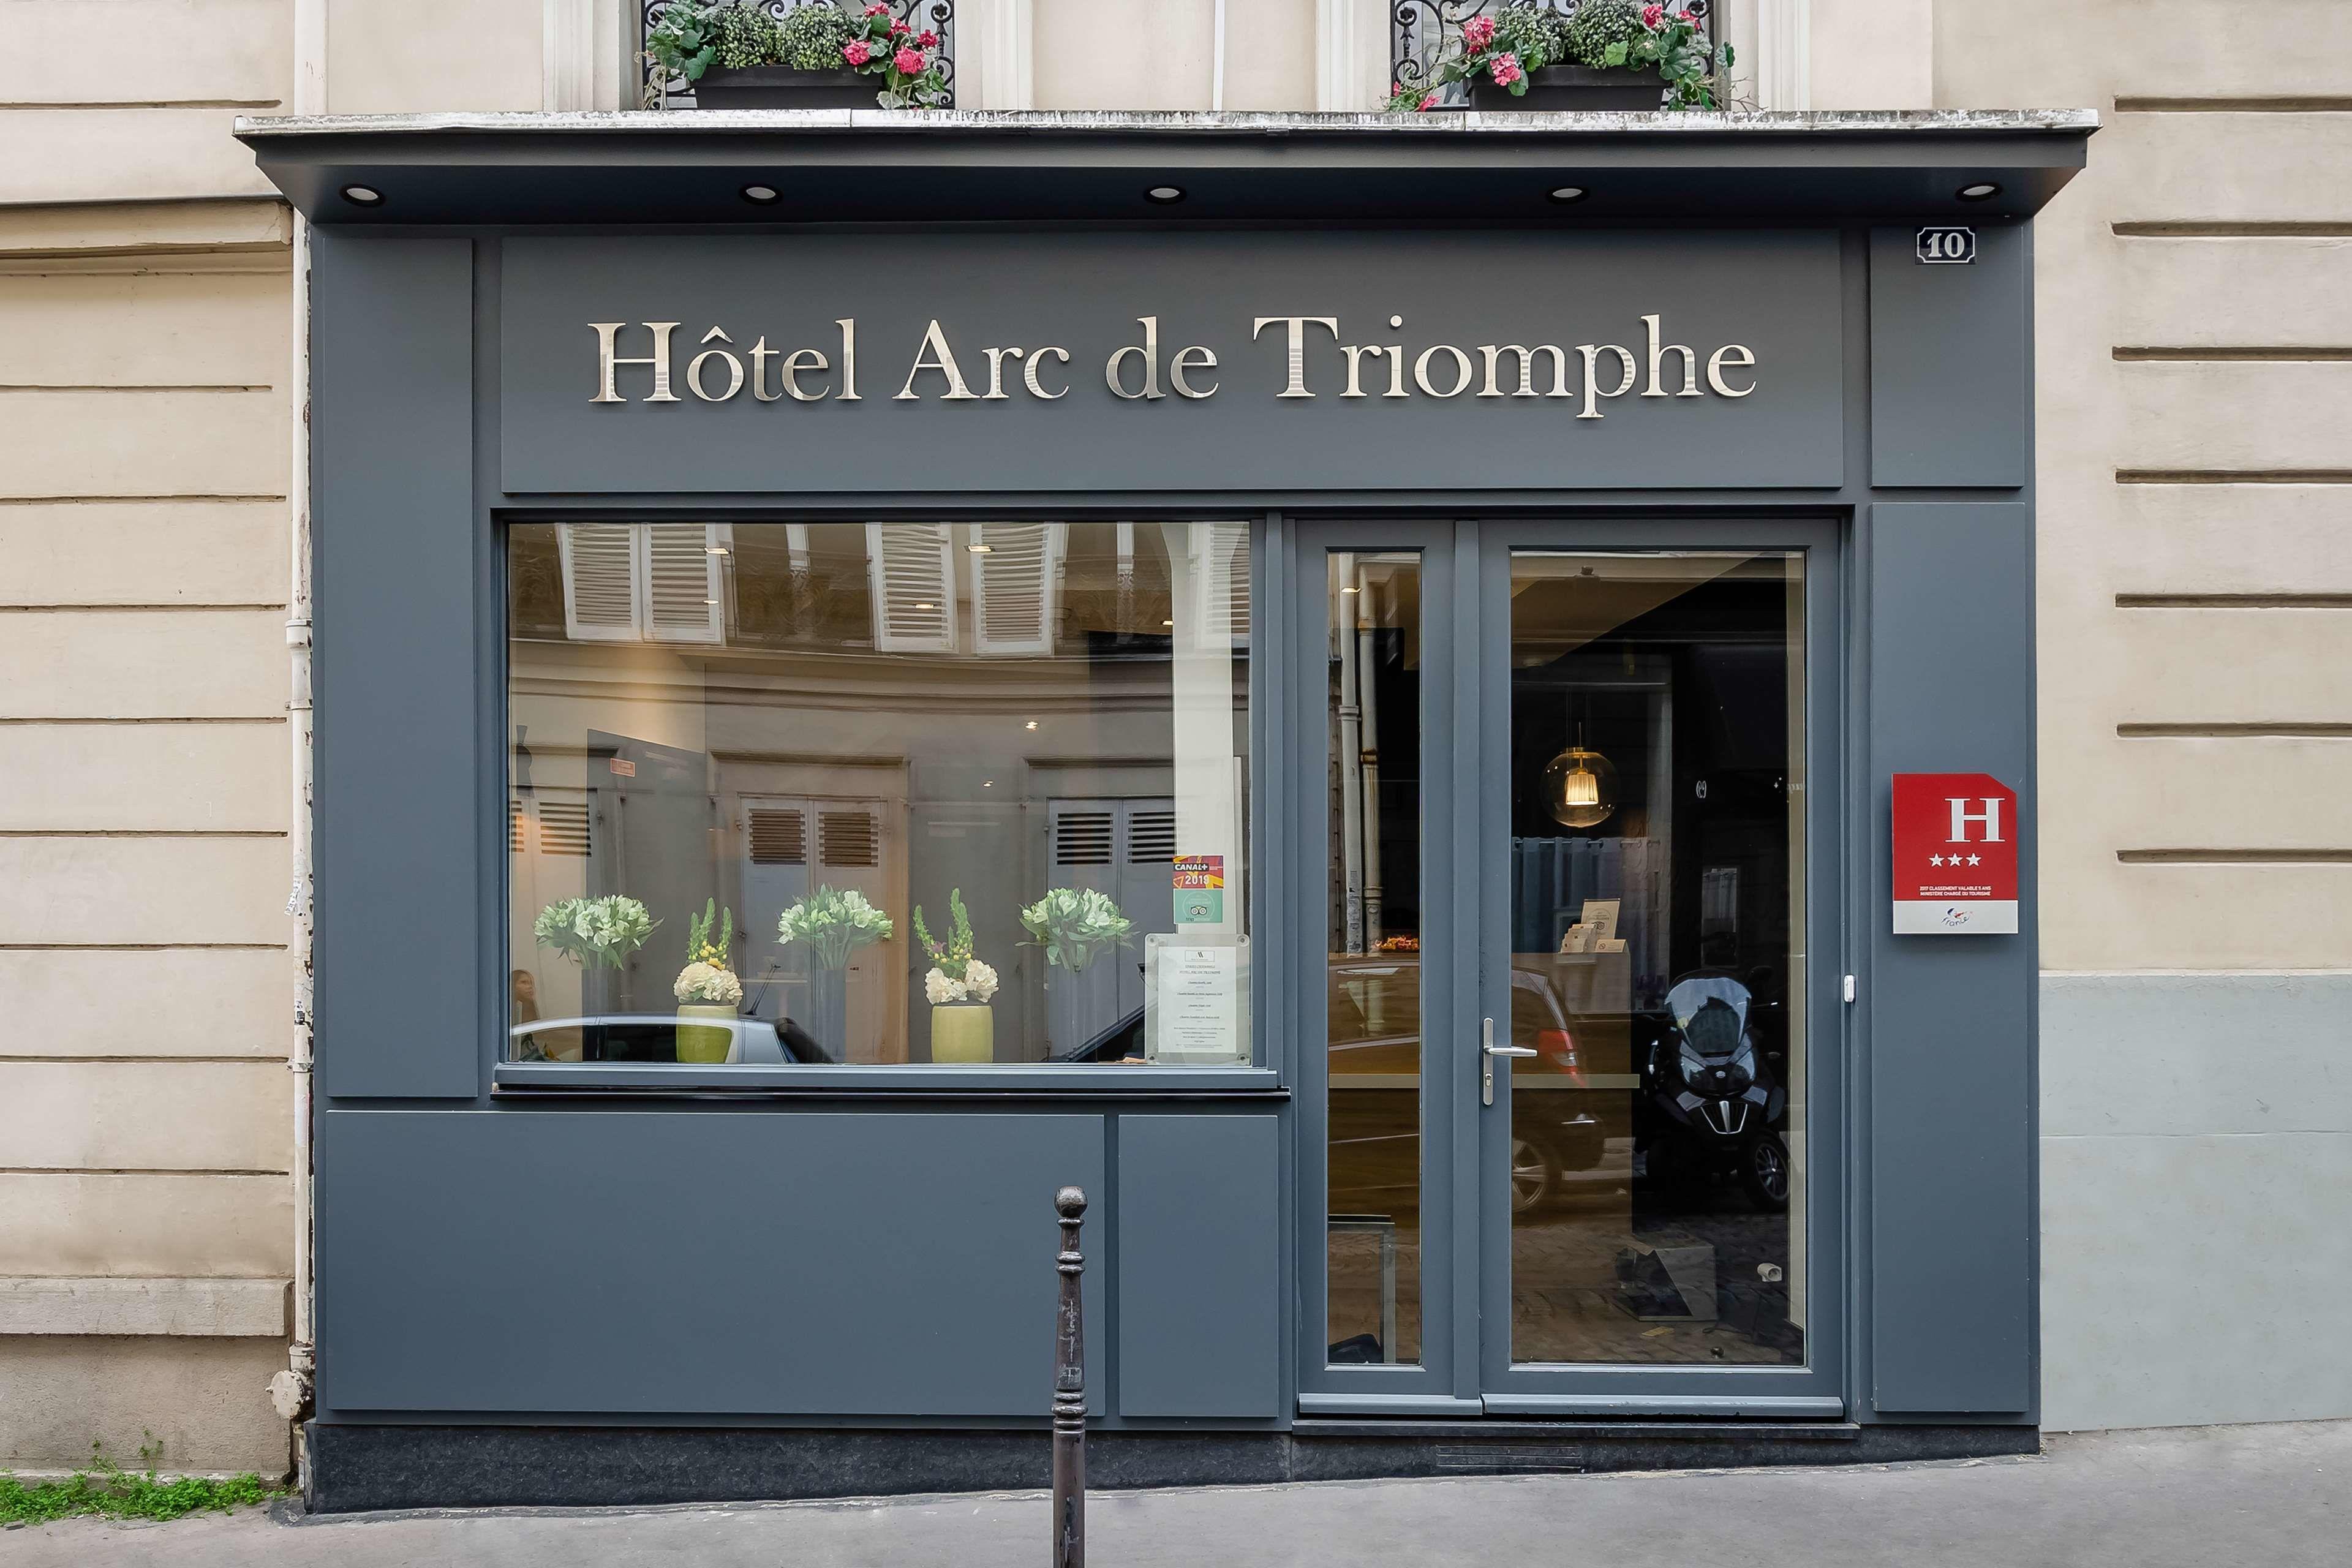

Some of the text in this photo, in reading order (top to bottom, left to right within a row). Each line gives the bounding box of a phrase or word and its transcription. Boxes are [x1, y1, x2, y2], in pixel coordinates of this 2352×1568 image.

[1928, 233, 1964, 257] 10
[587, 314, 1757, 418] Hôtel Arc de Triomphe
[1945, 797, 2005, 842] H
[1185, 875, 1209, 884] 2019
